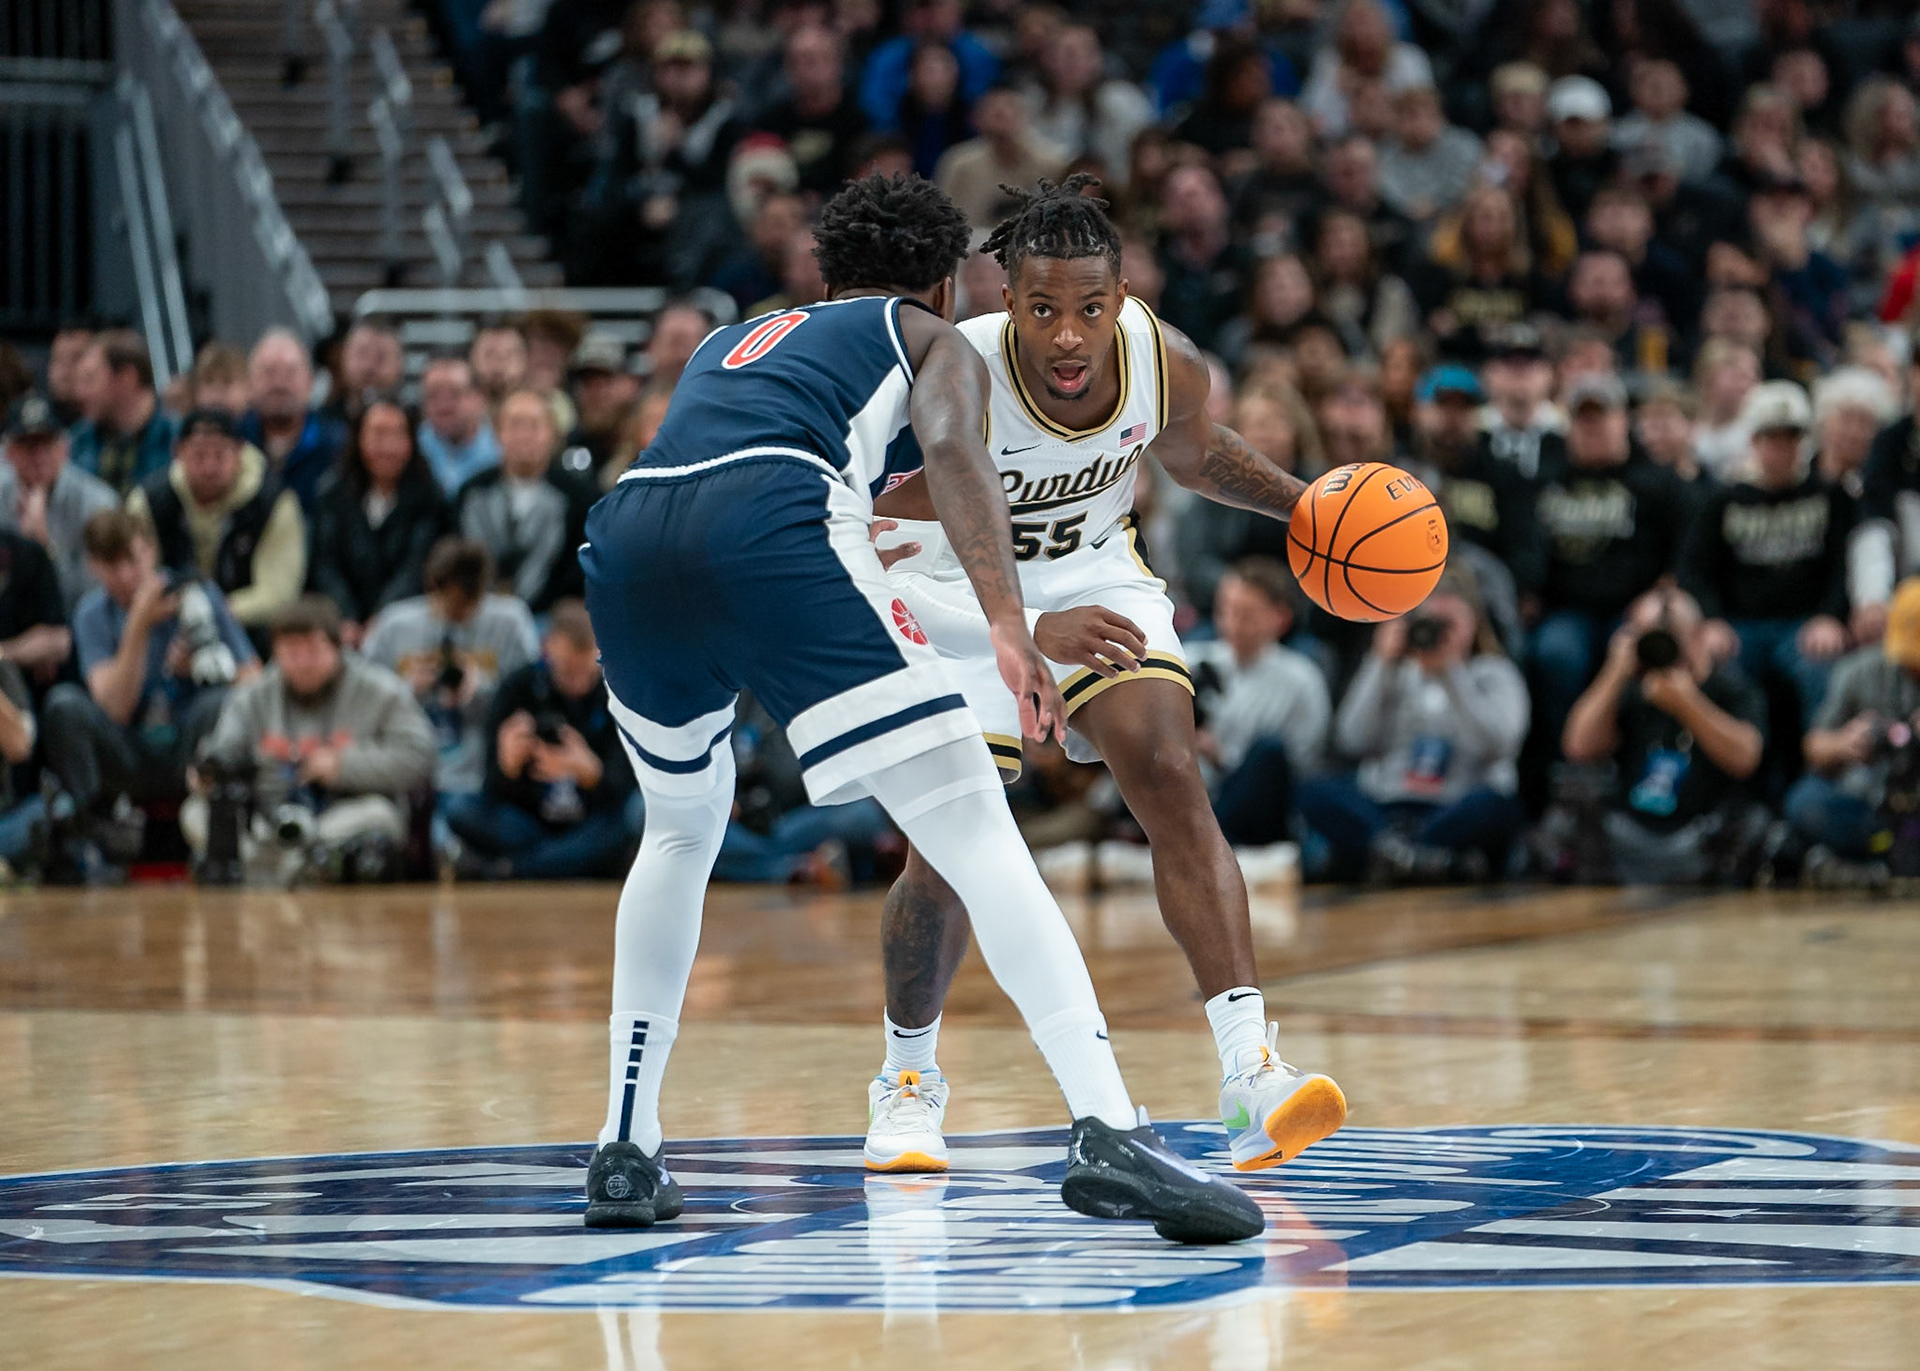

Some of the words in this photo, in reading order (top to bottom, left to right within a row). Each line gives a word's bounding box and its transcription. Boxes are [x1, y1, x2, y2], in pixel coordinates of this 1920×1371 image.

[721, 310, 811, 370] 0
[1000, 443, 1144, 506] Purdue
[1011, 511, 1089, 562] 55
